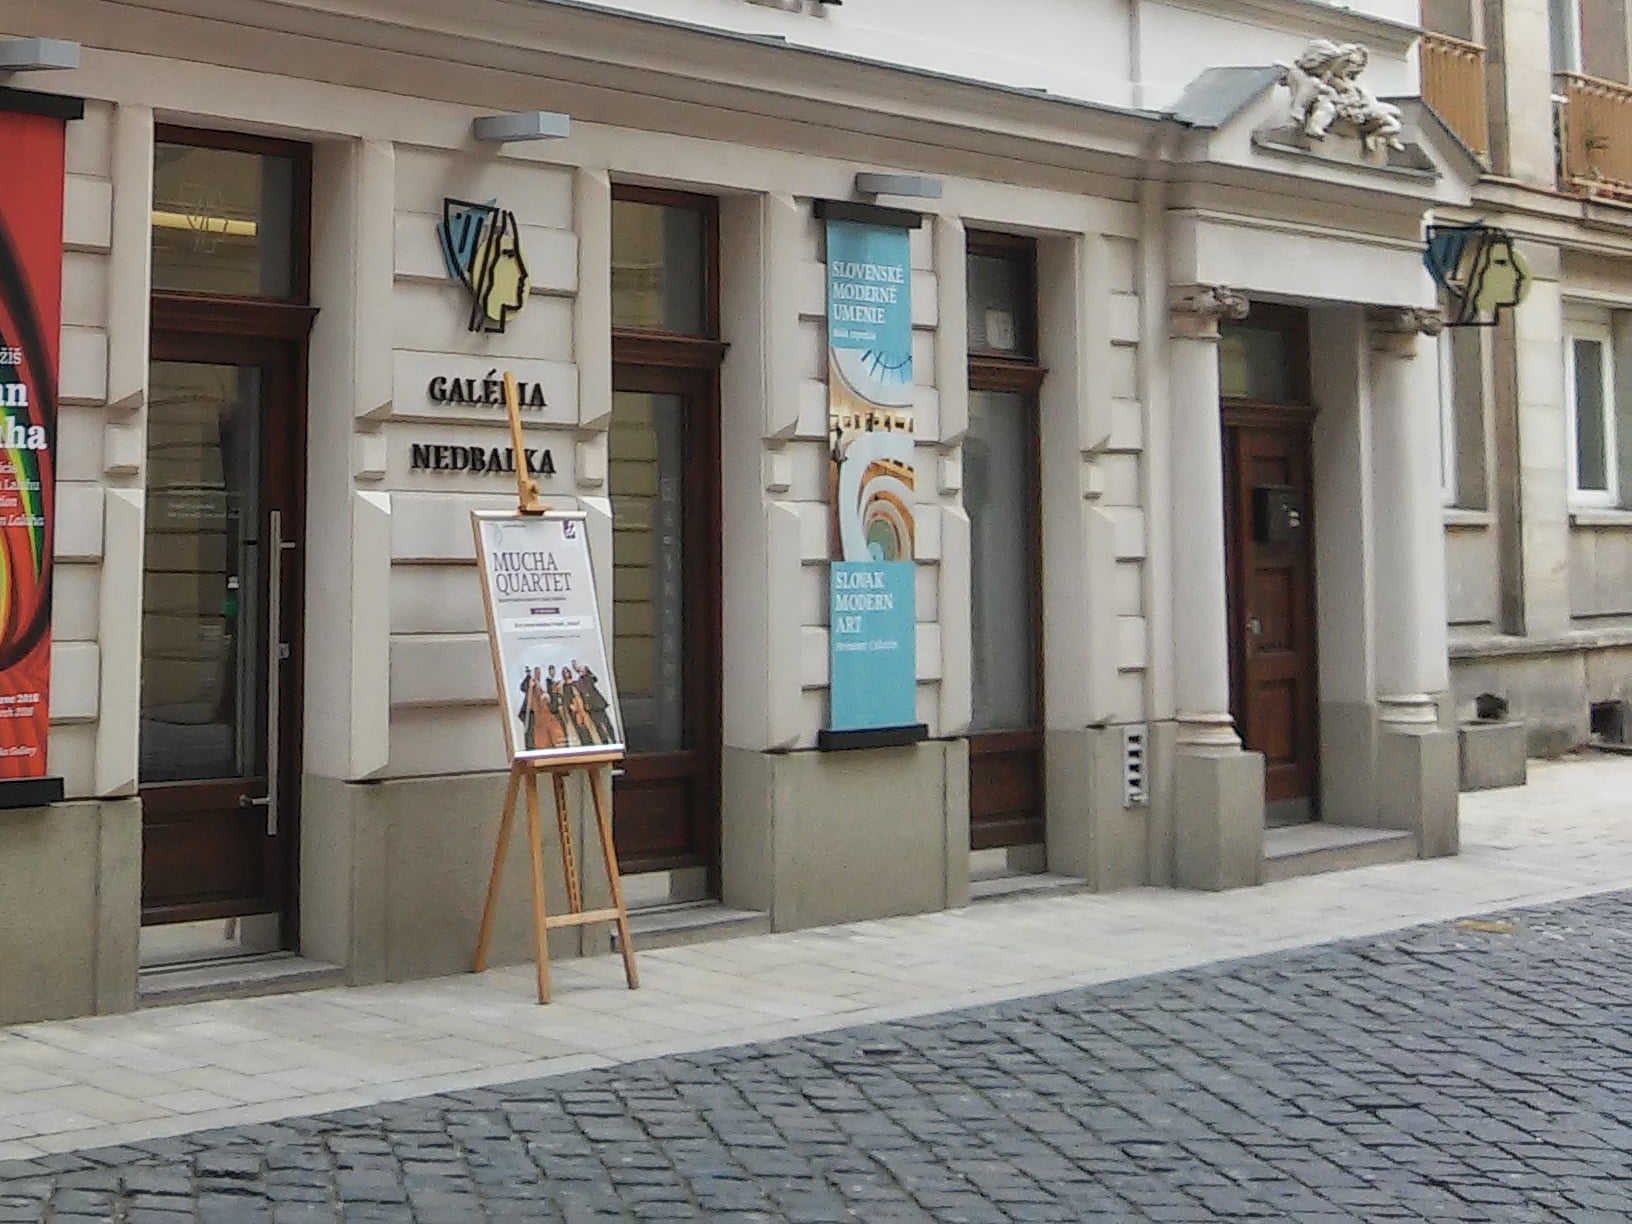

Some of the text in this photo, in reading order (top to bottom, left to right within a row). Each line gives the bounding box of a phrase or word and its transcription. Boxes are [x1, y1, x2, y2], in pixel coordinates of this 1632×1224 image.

[832, 261, 905, 284] SLOVENSKÉ
[832, 282, 897, 304] MODERNÉ
[833, 303, 885, 324] UMENIE
[492, 552, 558, 572] MUCHA
[495, 572, 572, 595] QUARTET
[835, 572, 885, 590] SLOVAK
[835, 593, 894, 612] MODERN
[835, 615, 861, 633] ART
